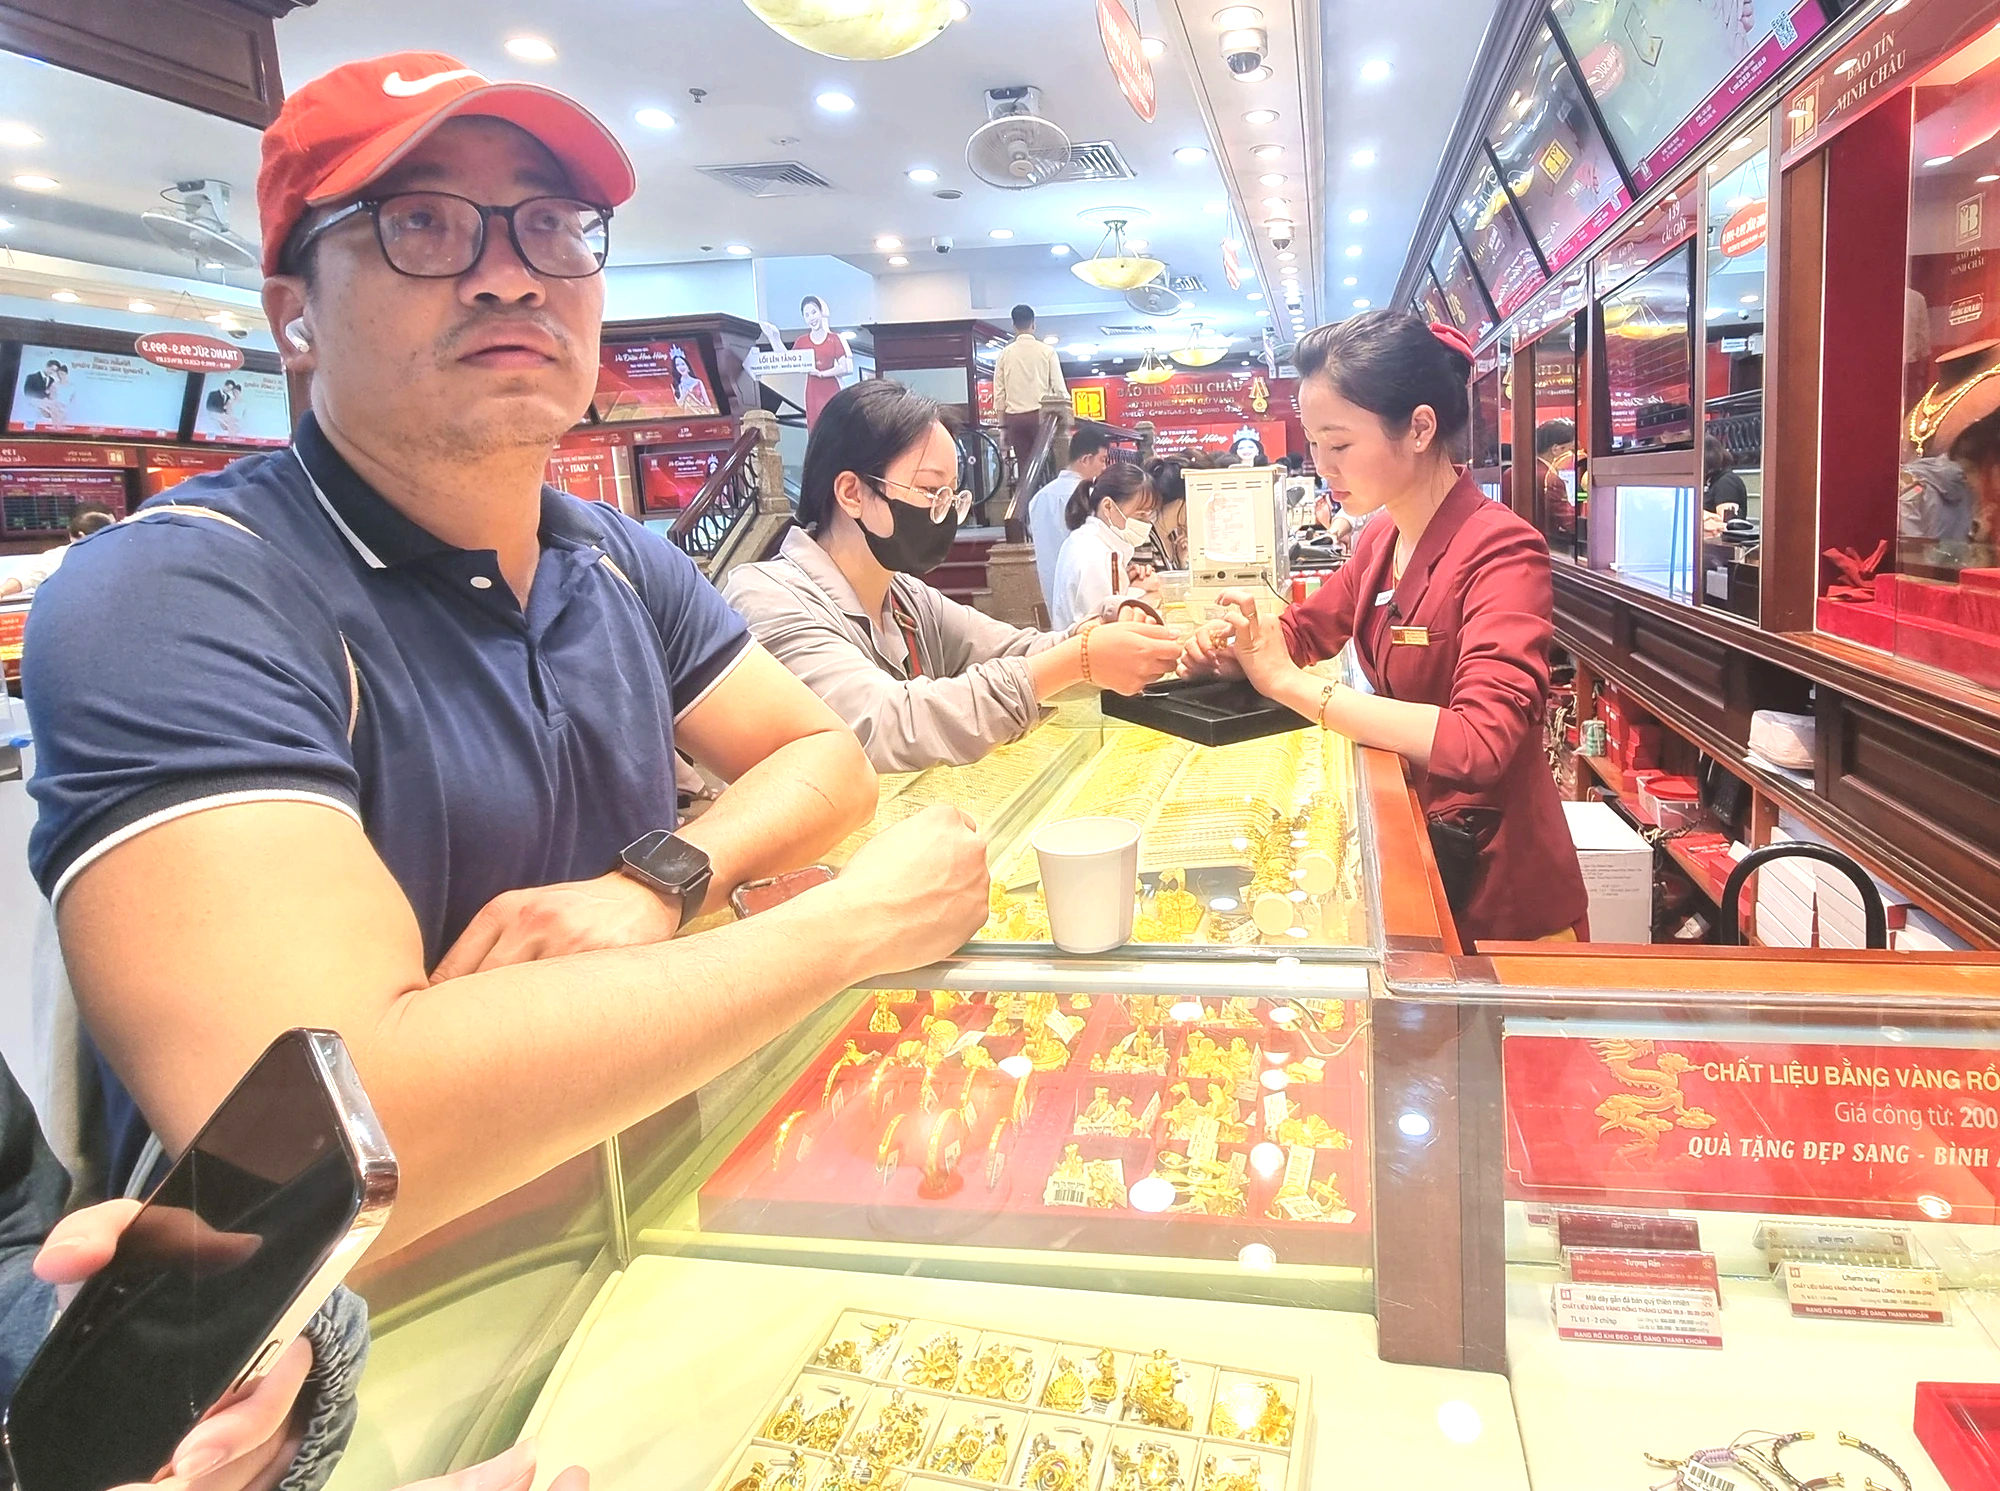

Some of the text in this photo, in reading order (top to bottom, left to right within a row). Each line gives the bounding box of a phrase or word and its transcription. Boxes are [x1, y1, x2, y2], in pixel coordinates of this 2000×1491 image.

[1847, 31, 1895, 82] BẢO TÍN
[1837, 49, 1906, 113] MINH CHÂU
[1668, 201, 1680, 221] 139
[570, 463, 589, 473] ITALY
[1703, 1056, 1764, 1083] CHẤT
[1770, 1061, 1819, 1088] LIỆU
[1826, 1057, 1890, 1087] BẰNG
[1896, 1064, 1961, 1090] VÀNG
[1834, 1102, 1998, 1130] Giá công từ: 200
[1688, 1132, 1732, 1159] QUÀ
[1740, 1136, 1795, 1163] TẶNG
[1803, 1141, 1846, 1165] ĐẸP
[1852, 1143, 1910, 1165] SANG
[1934, 1143, 1989, 1167] BÌNH
[1625, 1258, 1661, 1269] Tượng Rắn
